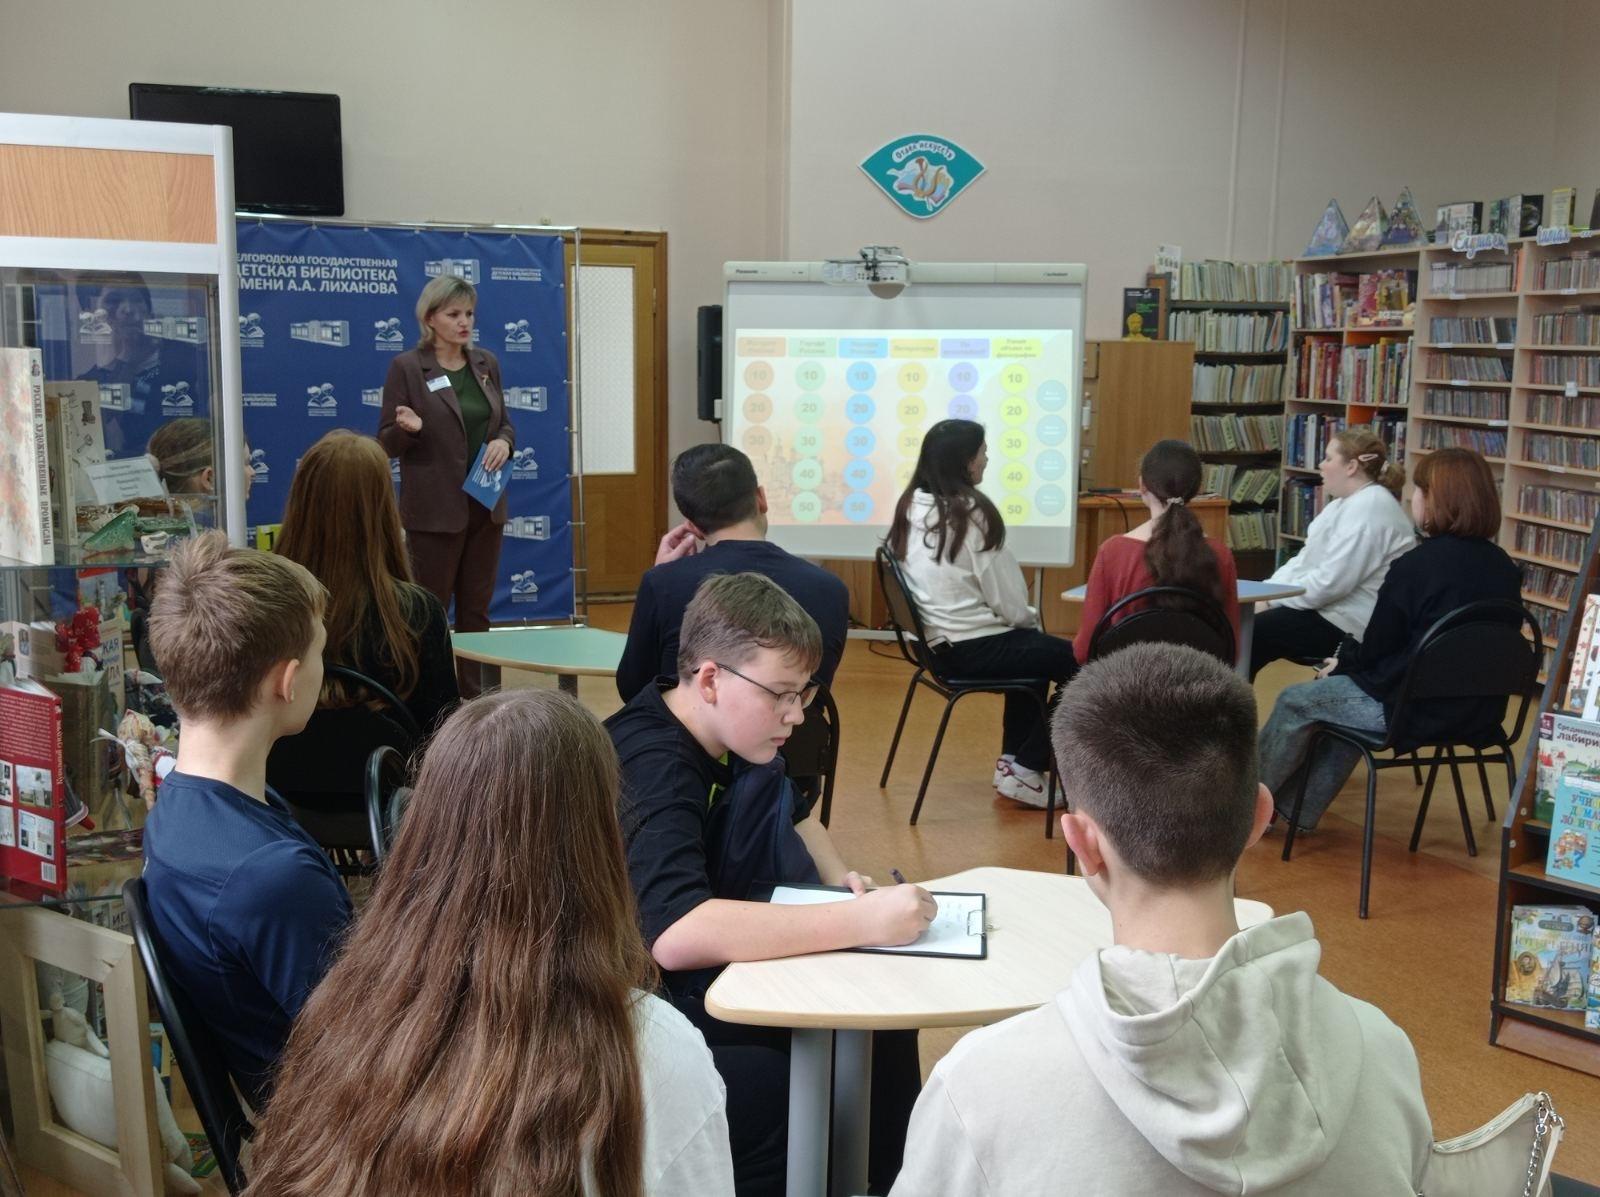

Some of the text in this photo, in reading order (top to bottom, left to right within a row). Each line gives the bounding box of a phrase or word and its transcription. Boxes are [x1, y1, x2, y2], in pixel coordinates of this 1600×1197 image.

[237, 253, 398, 268] ЕЛГОРОДСКАЯ ГОСУДАРСТВЕННАЯ
[300, 266, 398, 281] БИБЛИОТЕКА
[240, 278, 398, 295] МЕНИ А.А. ЛИХАНОВА
[753, 371, 767, 380] 10
[804, 371, 817, 380] 10
[855, 372, 868, 381] 10
[906, 373, 920, 382] 10
[957, 372, 971, 381] 10
[1008, 374, 1023, 383] 10
[751, 403, 765, 413] 20
[802, 403, 816, 413] 20
[853, 404, 868, 413] 20
[904, 406, 919, 415] 20
[955, 405, 970, 414] 20
[1007, 406, 1022, 416] 20
[750, 436, 765, 445] 30
[801, 436, 816, 446] 30
[853, 437, 868, 446] 30
[904, 438, 919, 448] 30
[1006, 439, 1021, 448] 30
[32, 384, 43, 418] РУССКИЕ
[40, 501, 52, 546] ПРОМЫСЛЫ
[800, 470, 815, 479] 40
[851, 470, 866, 478] 40
[1007, 472, 1022, 481] 40
[799, 503, 814, 511] 50
[850, 503, 865, 511] 50
[1007, 505, 1022, 514] 50
[1557, 732, 1600, 747] лабири
